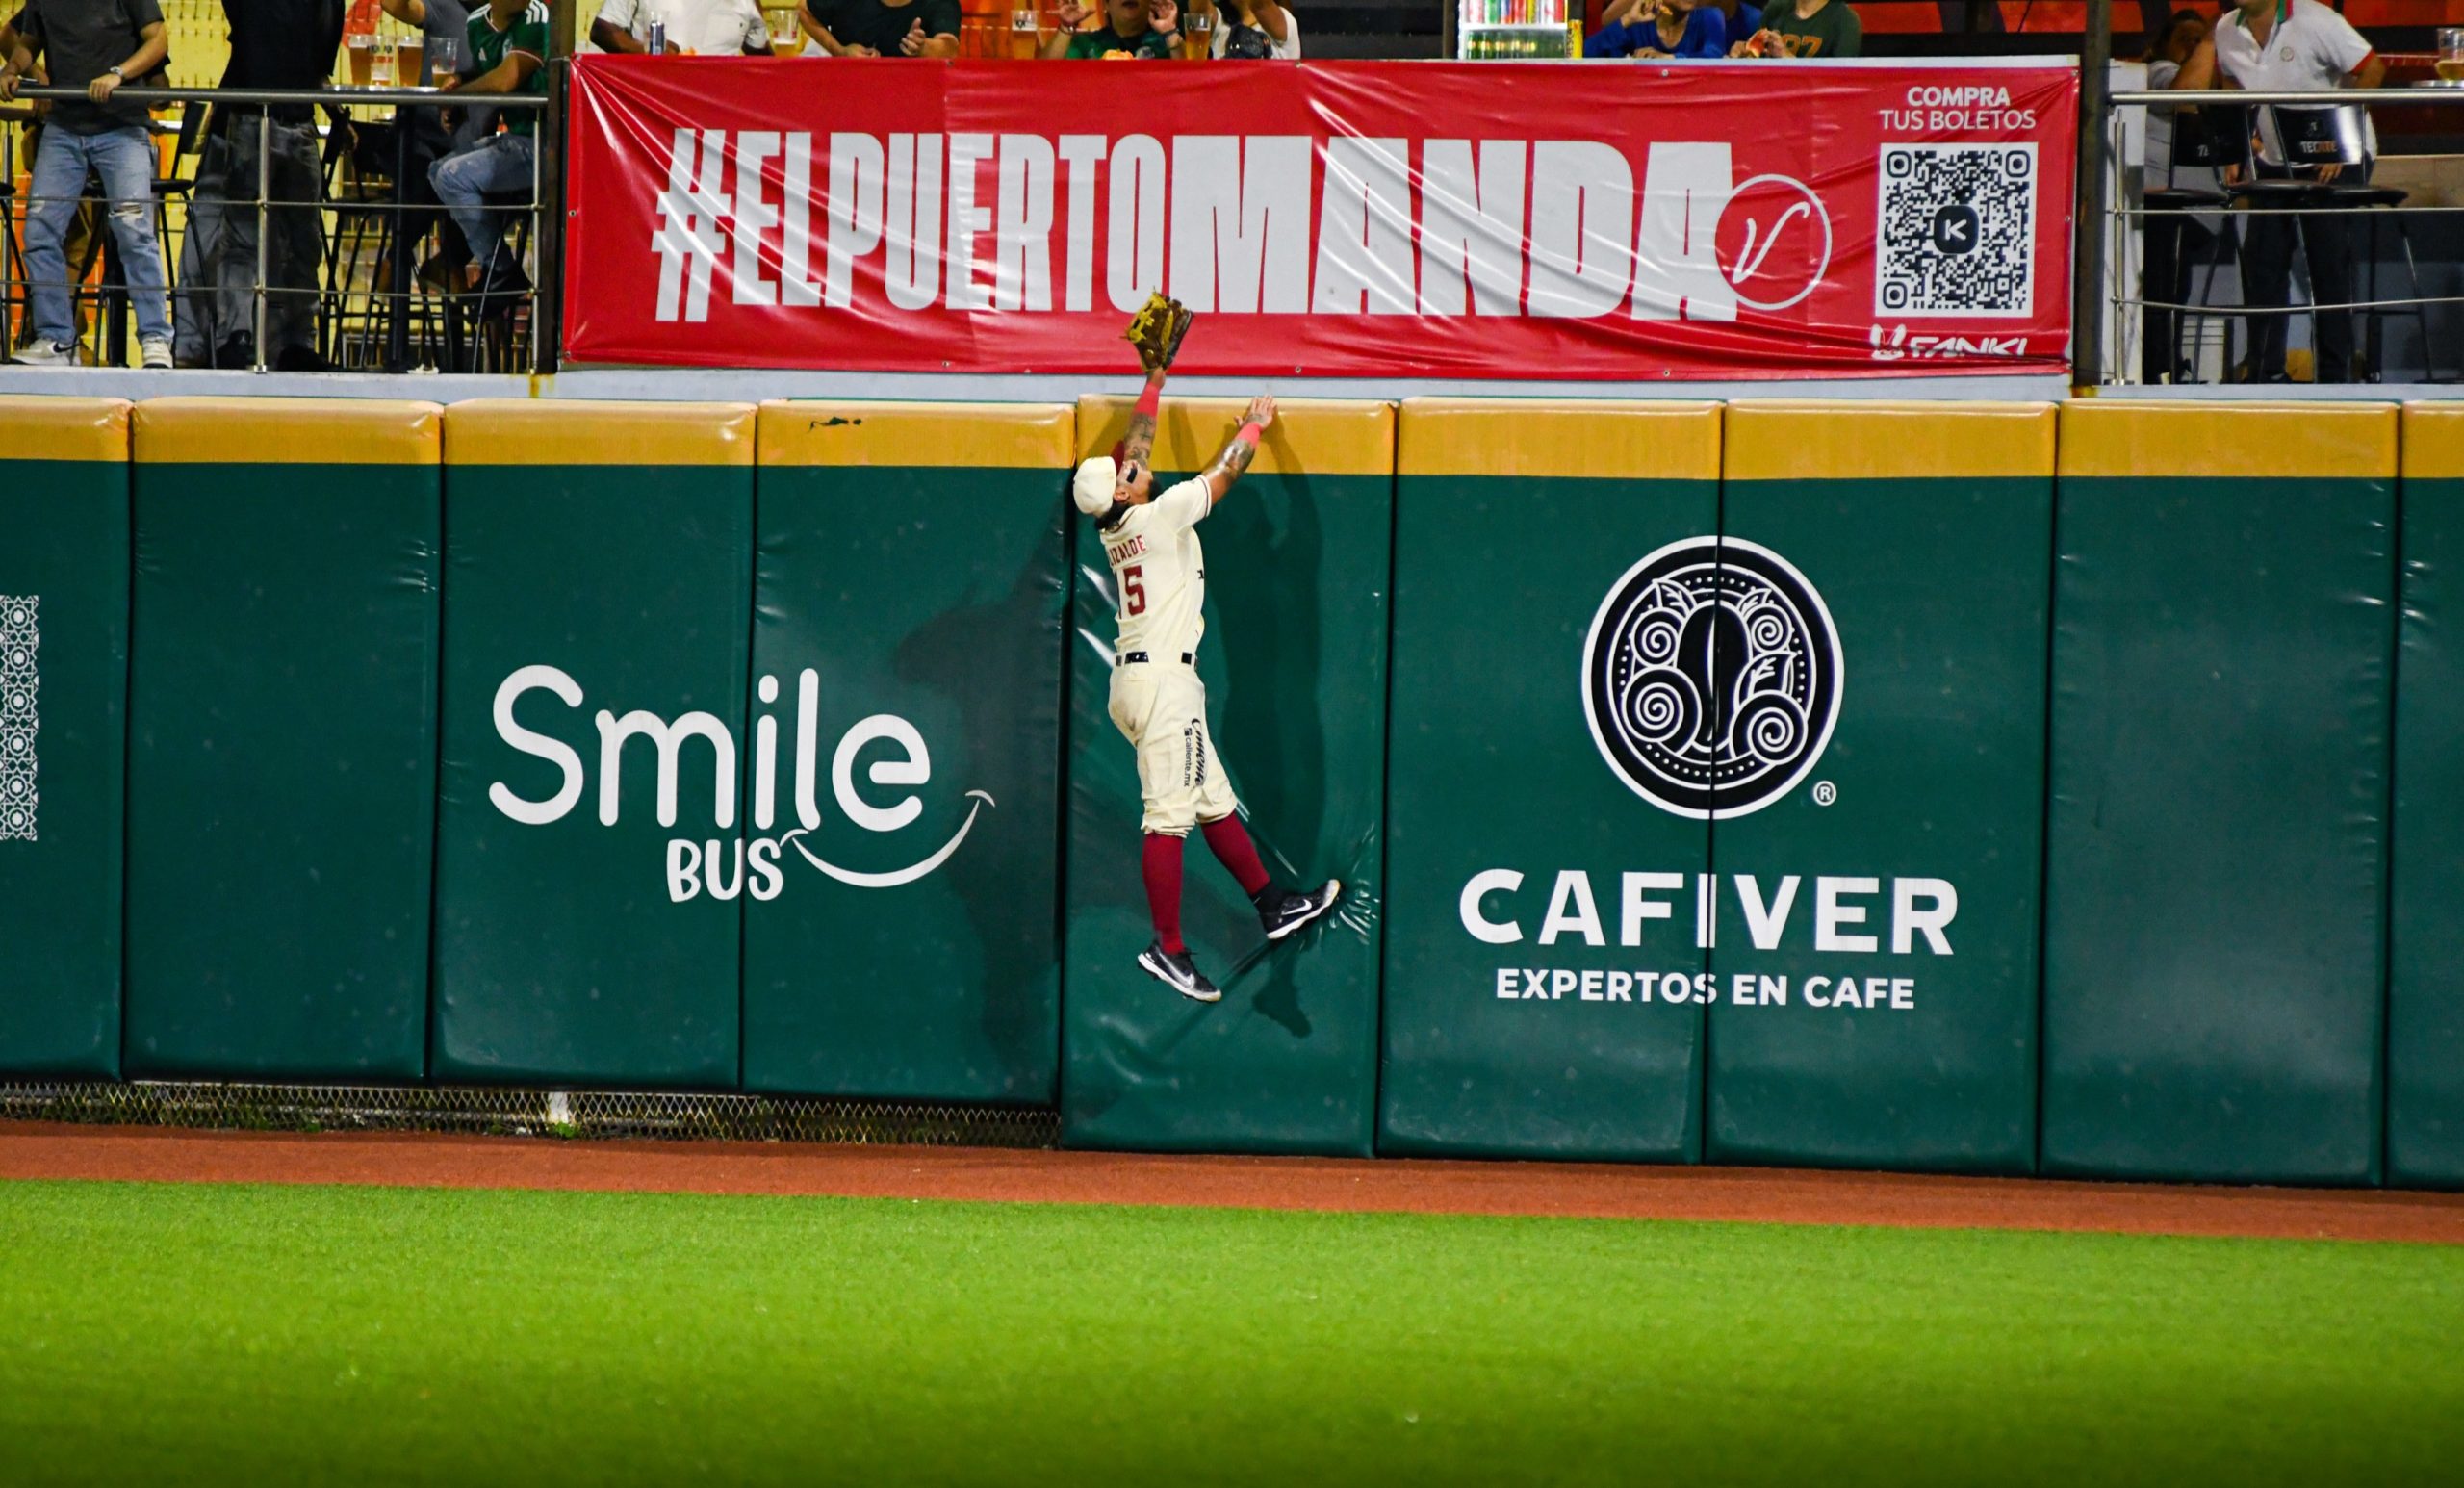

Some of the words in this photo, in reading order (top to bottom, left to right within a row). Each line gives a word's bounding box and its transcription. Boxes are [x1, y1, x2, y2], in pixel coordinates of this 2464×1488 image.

[1879, 110, 1924, 130] TUS
[1930, 109, 2037, 130] BOLETOS
[1907, 86, 2011, 107] COMPRA
[652, 128, 1736, 322] #ELPUERTOMANDA
[1945, 218, 1967, 241] K
[489, 664, 931, 833] Smile
[667, 837, 783, 903] BUS
[1459, 868, 1958, 955] CAFIVER
[1497, 968, 1717, 1005] EXPERTOS
[1732, 974, 1787, 1006] EN
[1804, 976, 1915, 1010] CAFE
